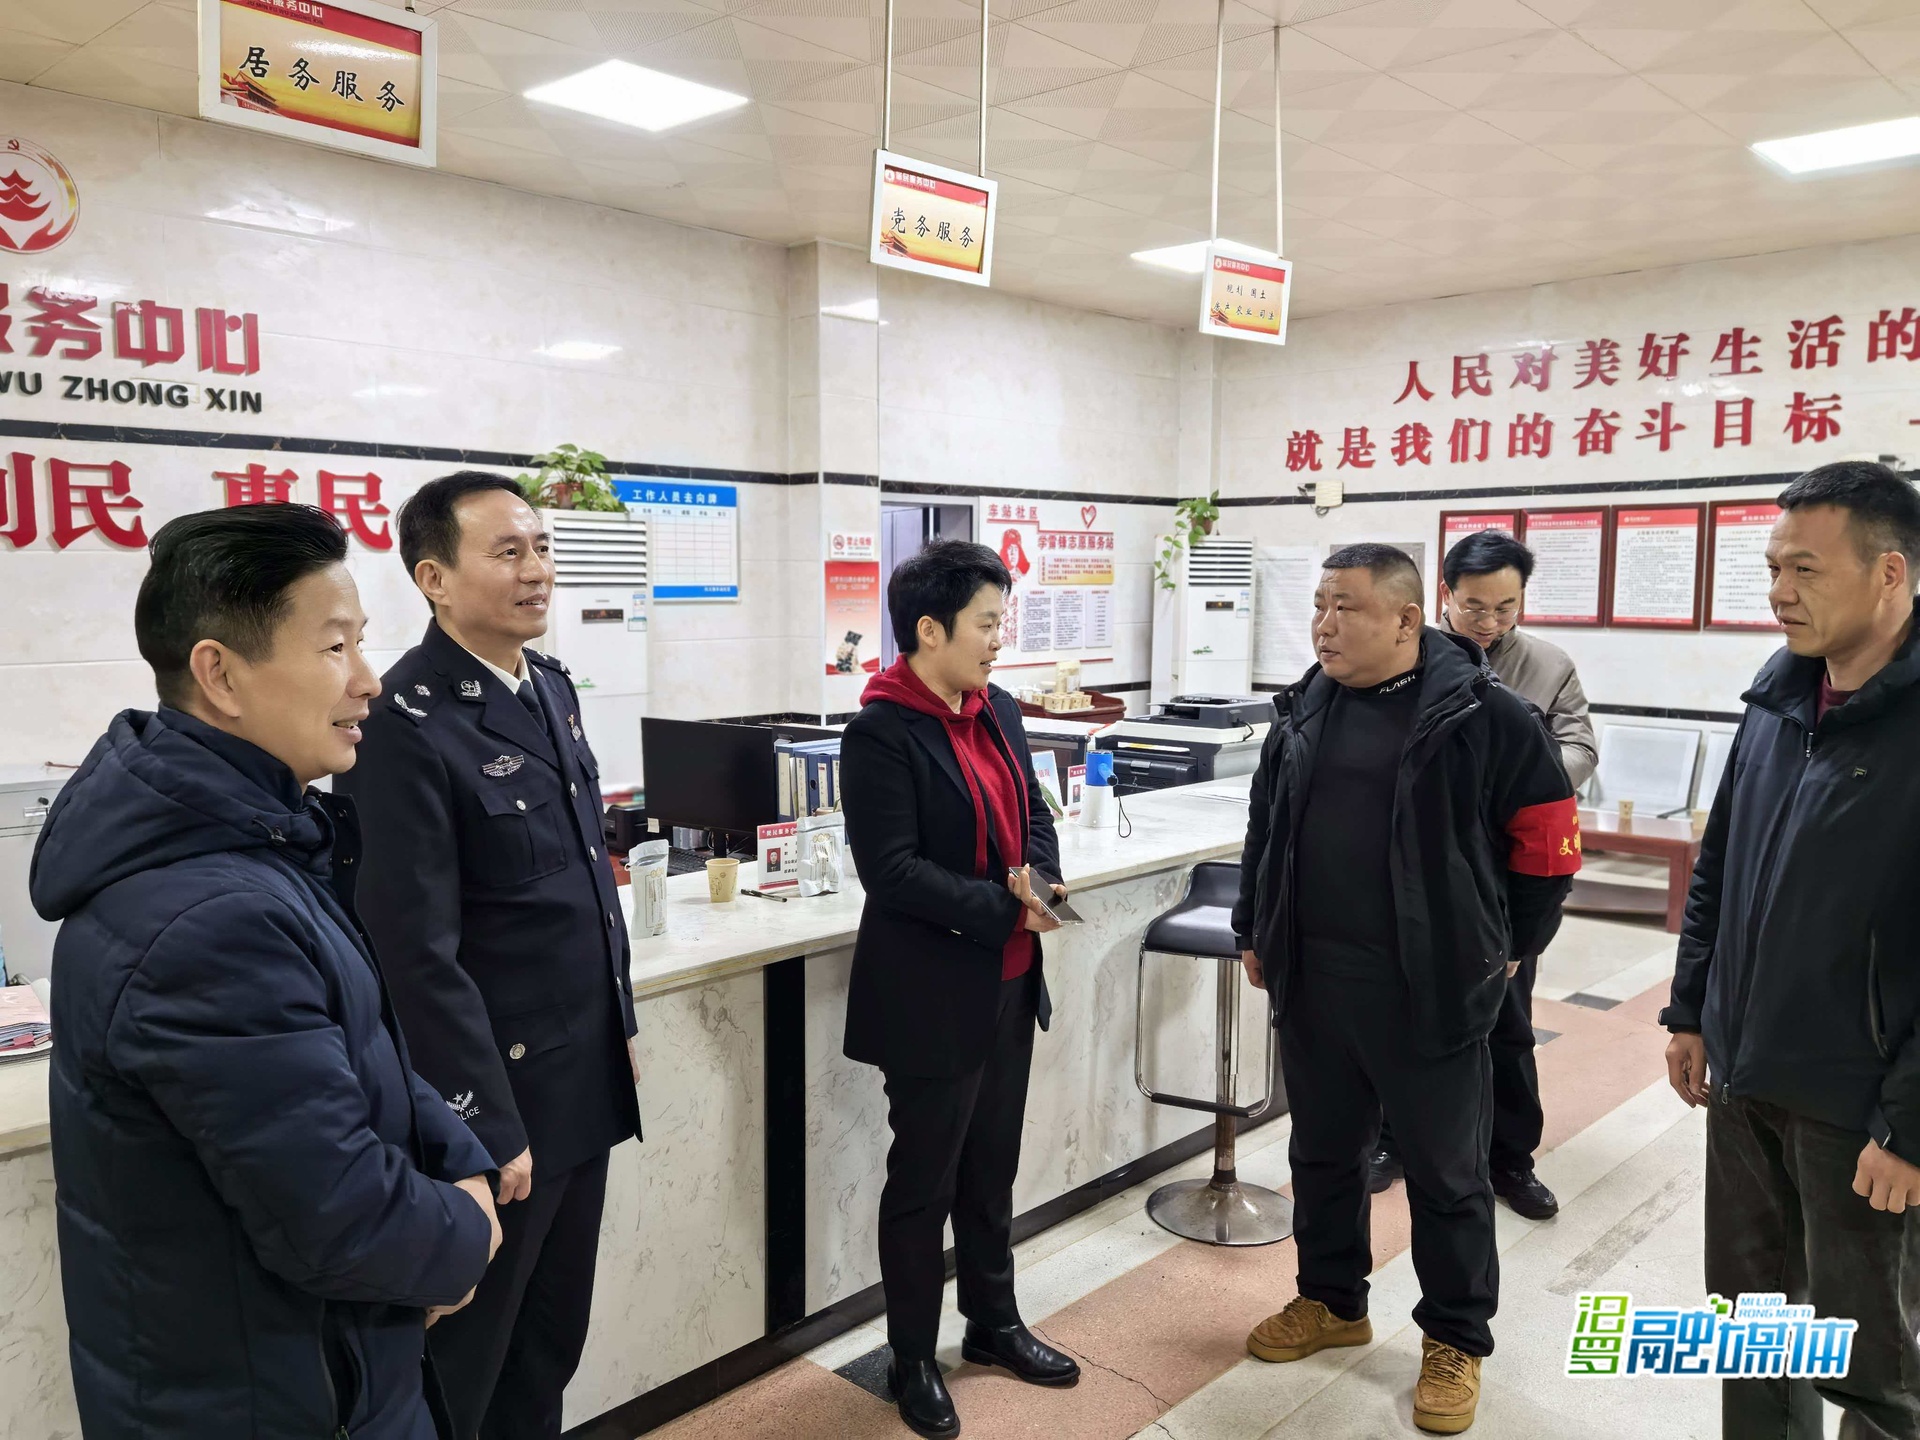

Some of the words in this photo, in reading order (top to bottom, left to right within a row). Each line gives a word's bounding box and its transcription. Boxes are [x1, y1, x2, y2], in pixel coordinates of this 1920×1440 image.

[239, 46, 405, 112] 居务服务
[891, 207, 974, 248] 党务服务
[1251, 288, 1266, 299] 国土
[0, 283, 260, 376] 务中心
[1393, 307, 1920, 405] 人民对美好生活的
[62, 375, 190, 408] ZHONG
[205, 387, 263, 413] XIN
[1285, 392, 1843, 473] 就是我们的奋斗目标
[632, 489, 718, 505] 工作人员去向牌
[988, 504, 1039, 519] 车站社区
[1039, 535, 1114, 551] 学雷锋志愿服务站
